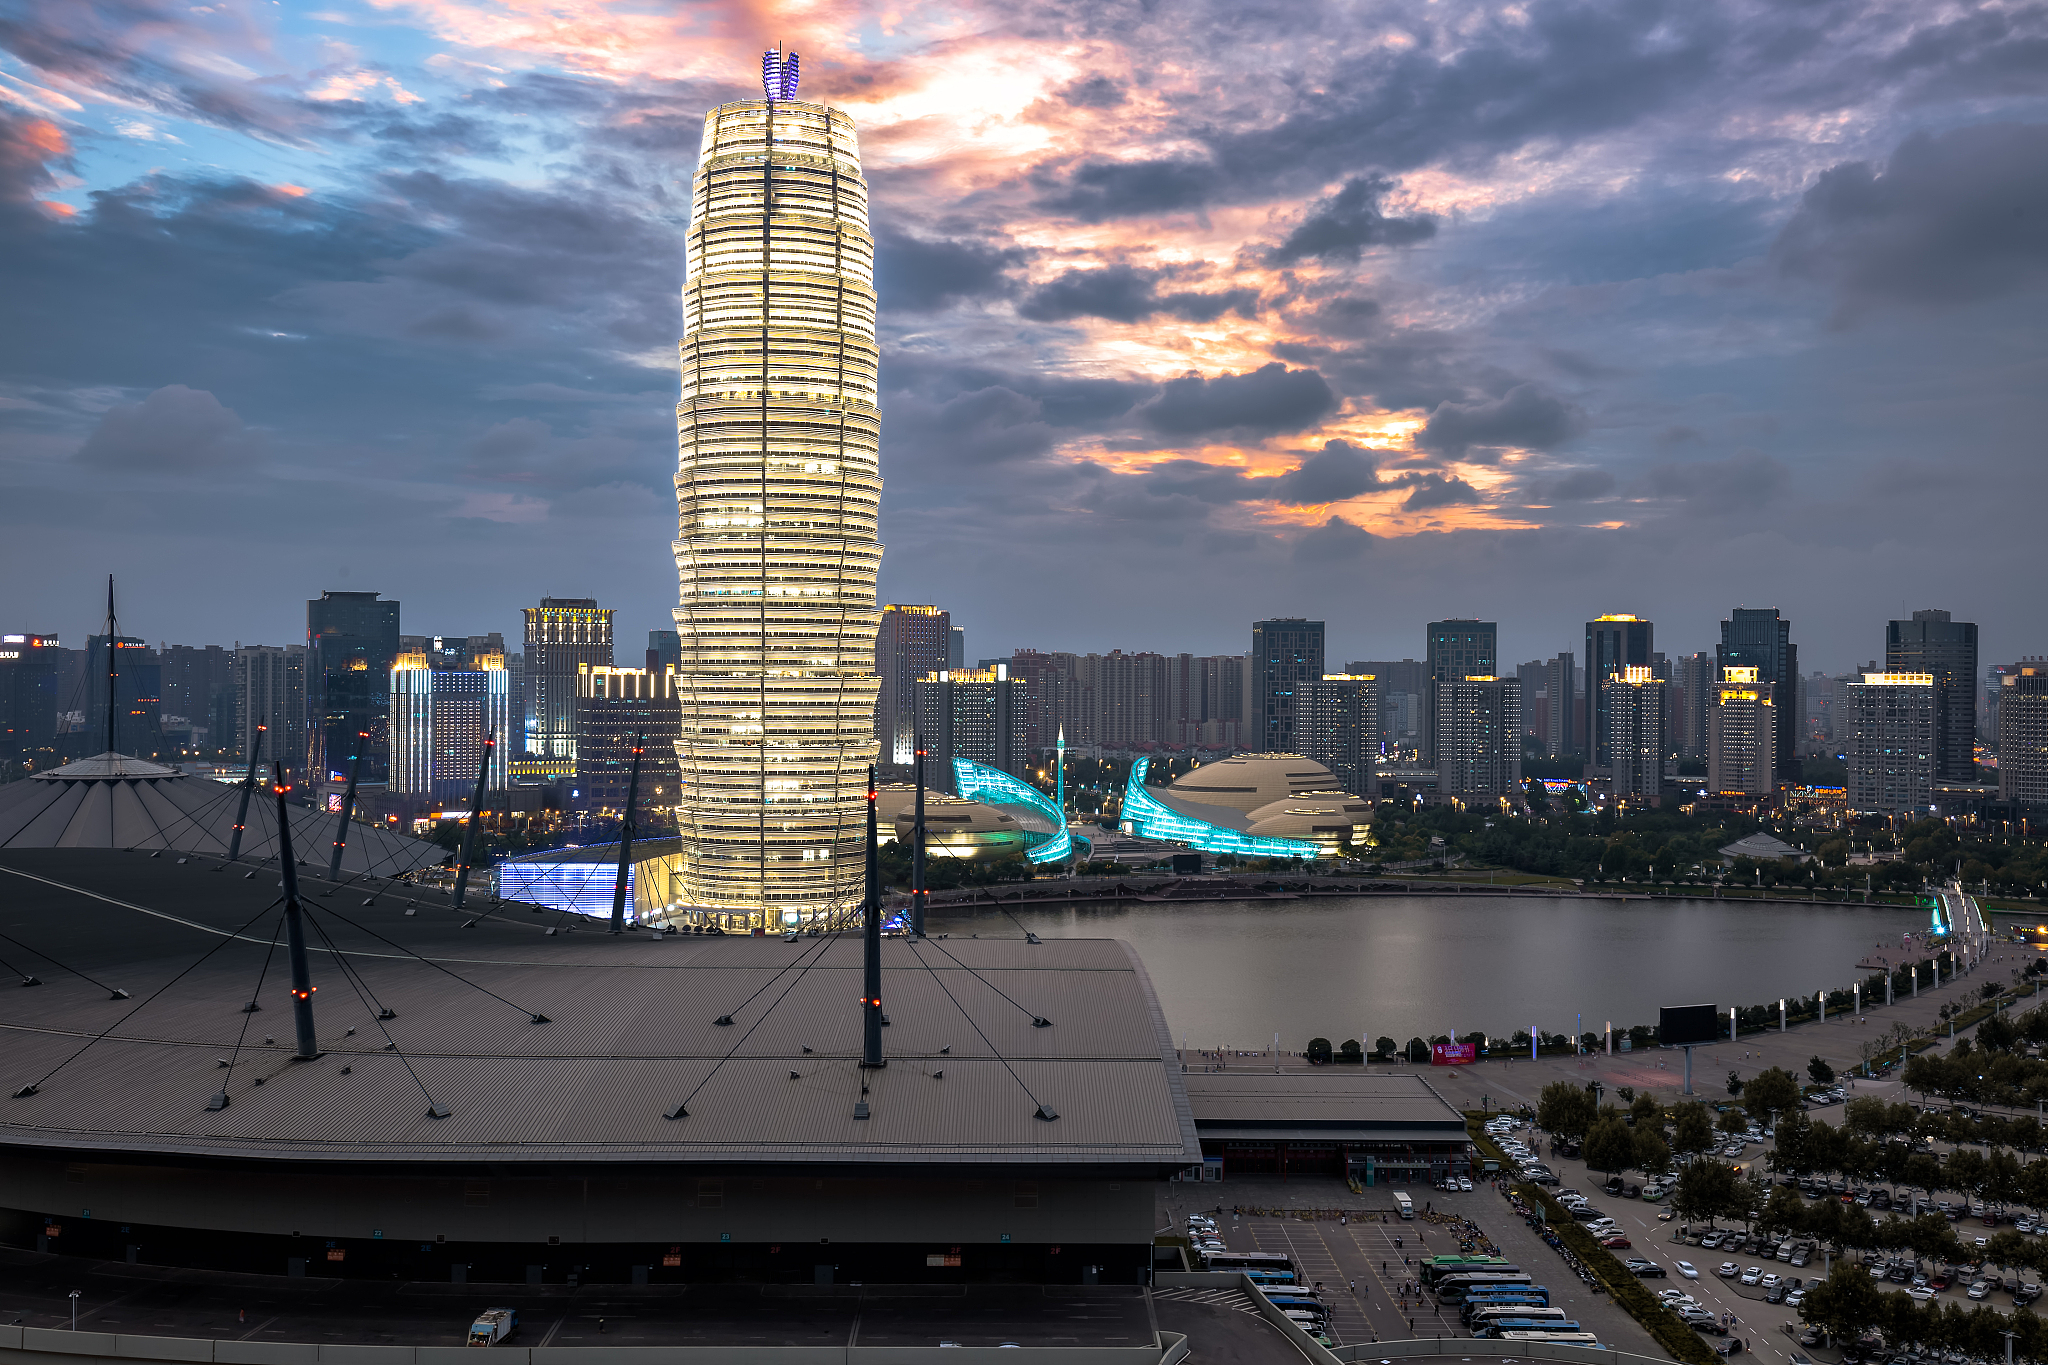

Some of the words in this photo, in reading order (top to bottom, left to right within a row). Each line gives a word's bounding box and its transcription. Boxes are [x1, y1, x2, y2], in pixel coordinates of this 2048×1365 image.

[44, 1217, 53, 1225] 2E
[120, 1226, 130, 1234] 2E
[325, 1241, 336, 1249] 2E
[421, 1244, 432, 1252] 2E
[670, 1246, 680, 1254] 2F
[770, 1246, 781, 1254] 2F
[950, 1246, 961, 1254] 2F
[1050, 1246, 1061, 1255] 2F
